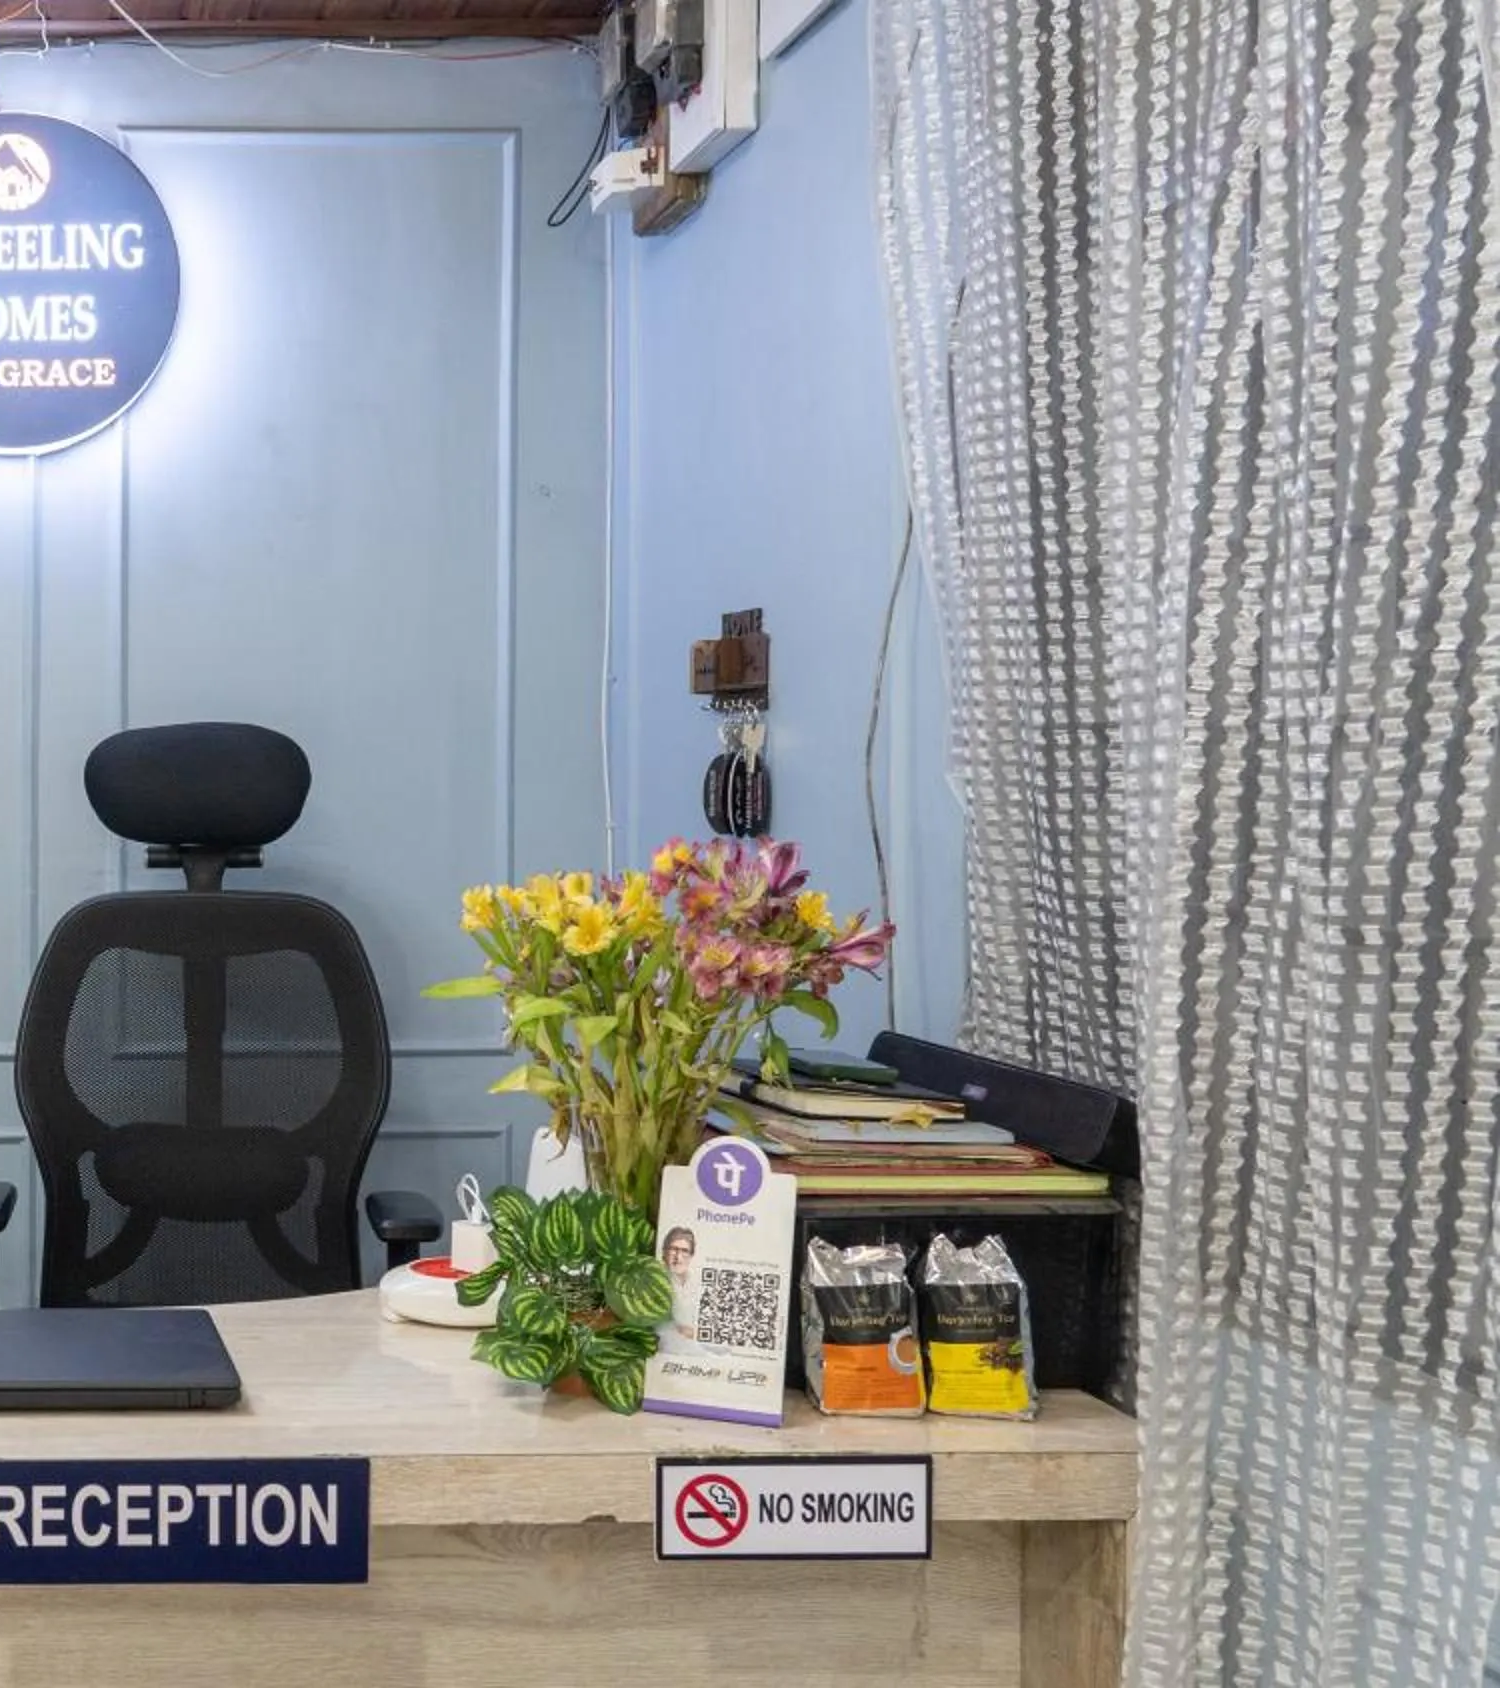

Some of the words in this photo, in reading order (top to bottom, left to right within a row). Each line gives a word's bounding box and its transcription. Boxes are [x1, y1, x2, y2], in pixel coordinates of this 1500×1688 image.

[713, 1151, 747, 1198] पे
[697, 1207, 756, 1226] PhonePe
[759, 1493, 794, 1523] NO
[801, 1492, 915, 1523] SMOKING
